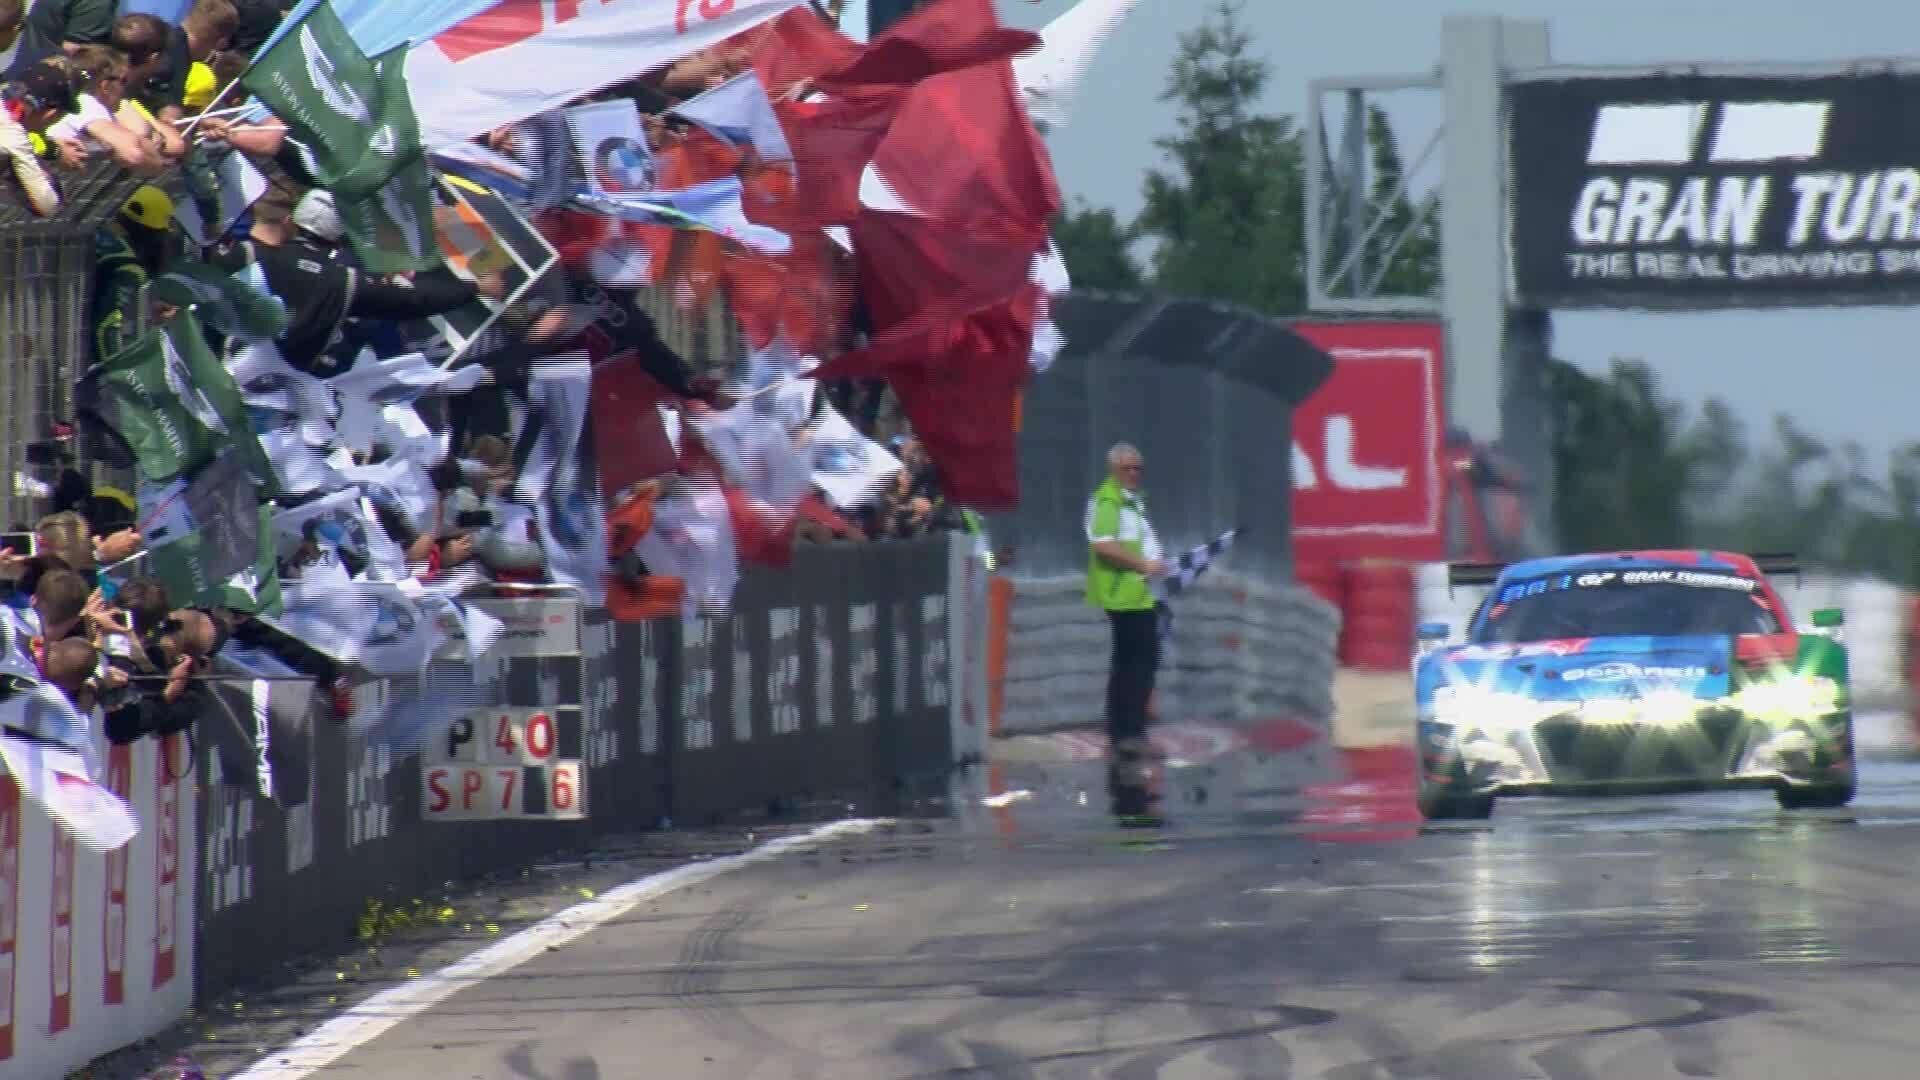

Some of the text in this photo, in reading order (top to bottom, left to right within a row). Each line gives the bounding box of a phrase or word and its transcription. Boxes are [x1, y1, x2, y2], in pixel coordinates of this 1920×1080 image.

[1569, 166, 1920, 247] GRAN TUR
[1565, 251, 1631, 278] THE
[1634, 251, 1729, 279] REAL
[1732, 249, 1876, 280] DRIVING
[447, 713, 557, 760] P 40
